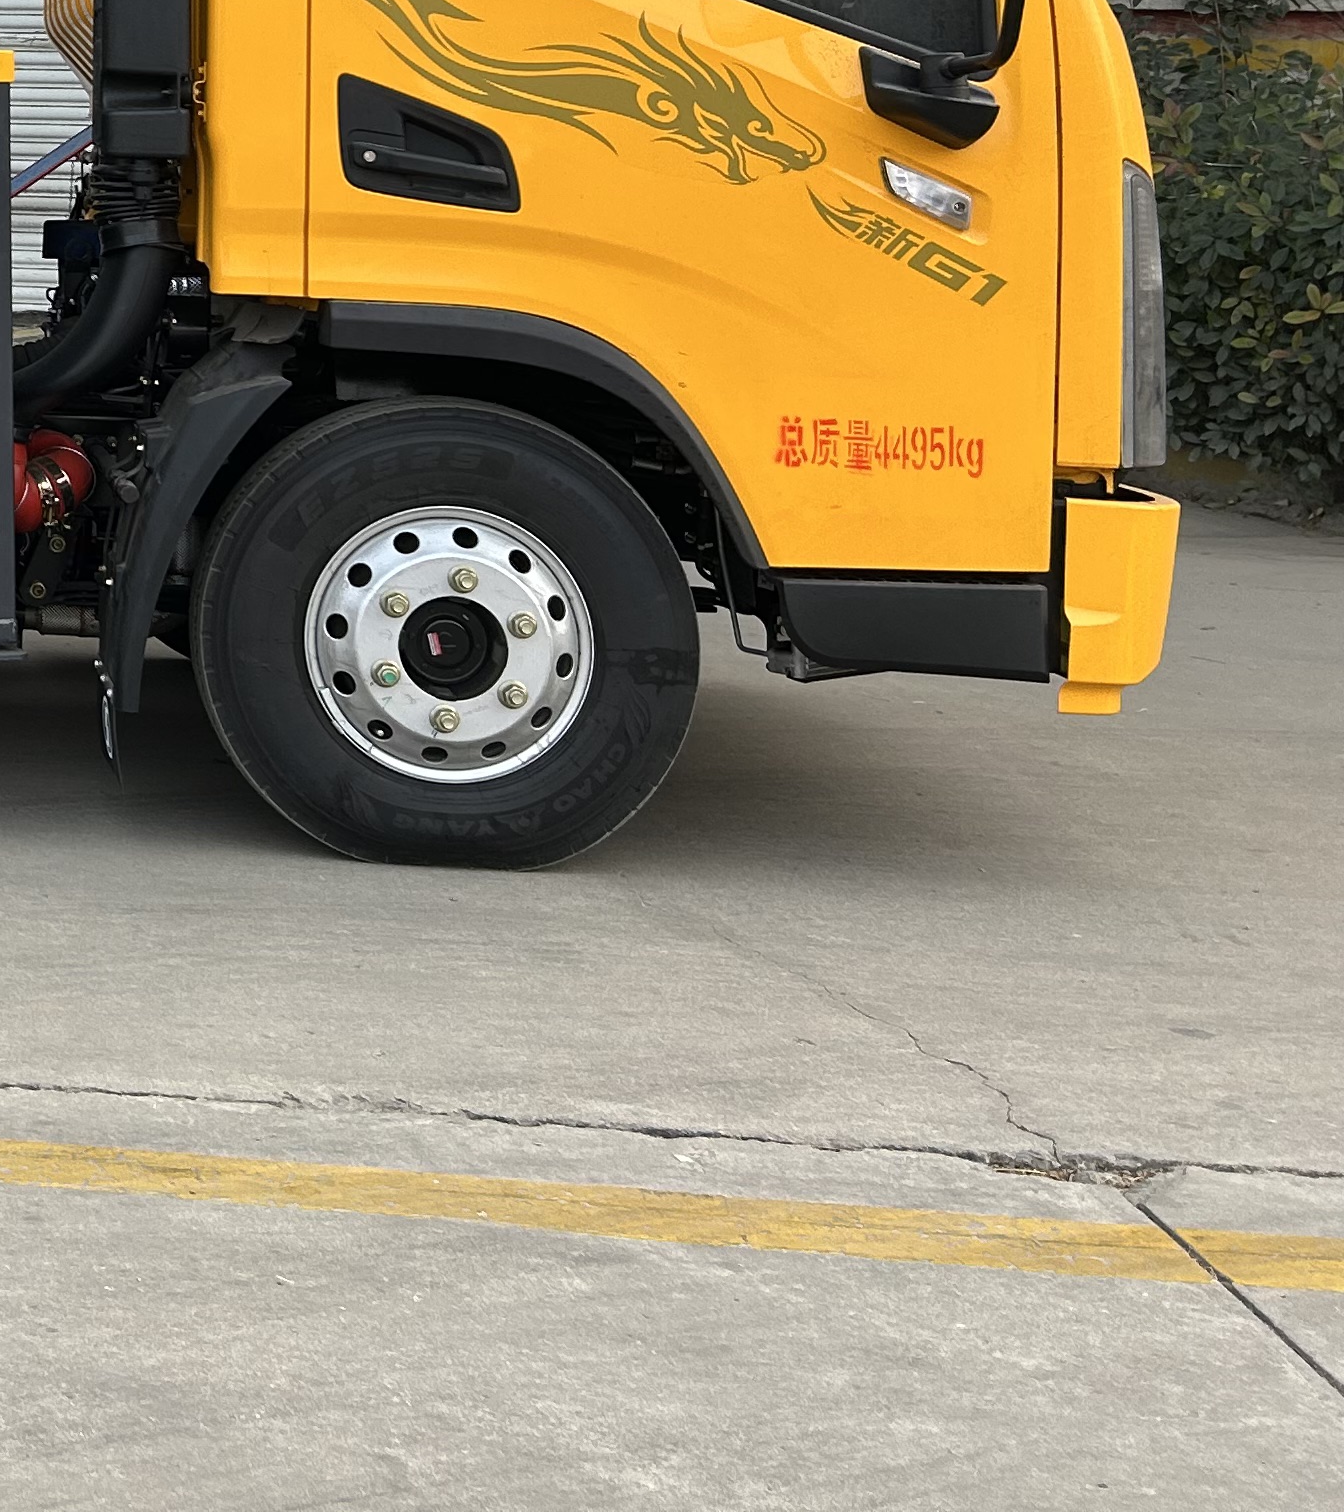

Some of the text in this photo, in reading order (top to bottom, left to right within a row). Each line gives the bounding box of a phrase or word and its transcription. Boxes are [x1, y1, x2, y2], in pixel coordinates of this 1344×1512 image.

[855, 213, 1008, 307] 新G1
[775, 415, 985, 479] 总质量4495kg
